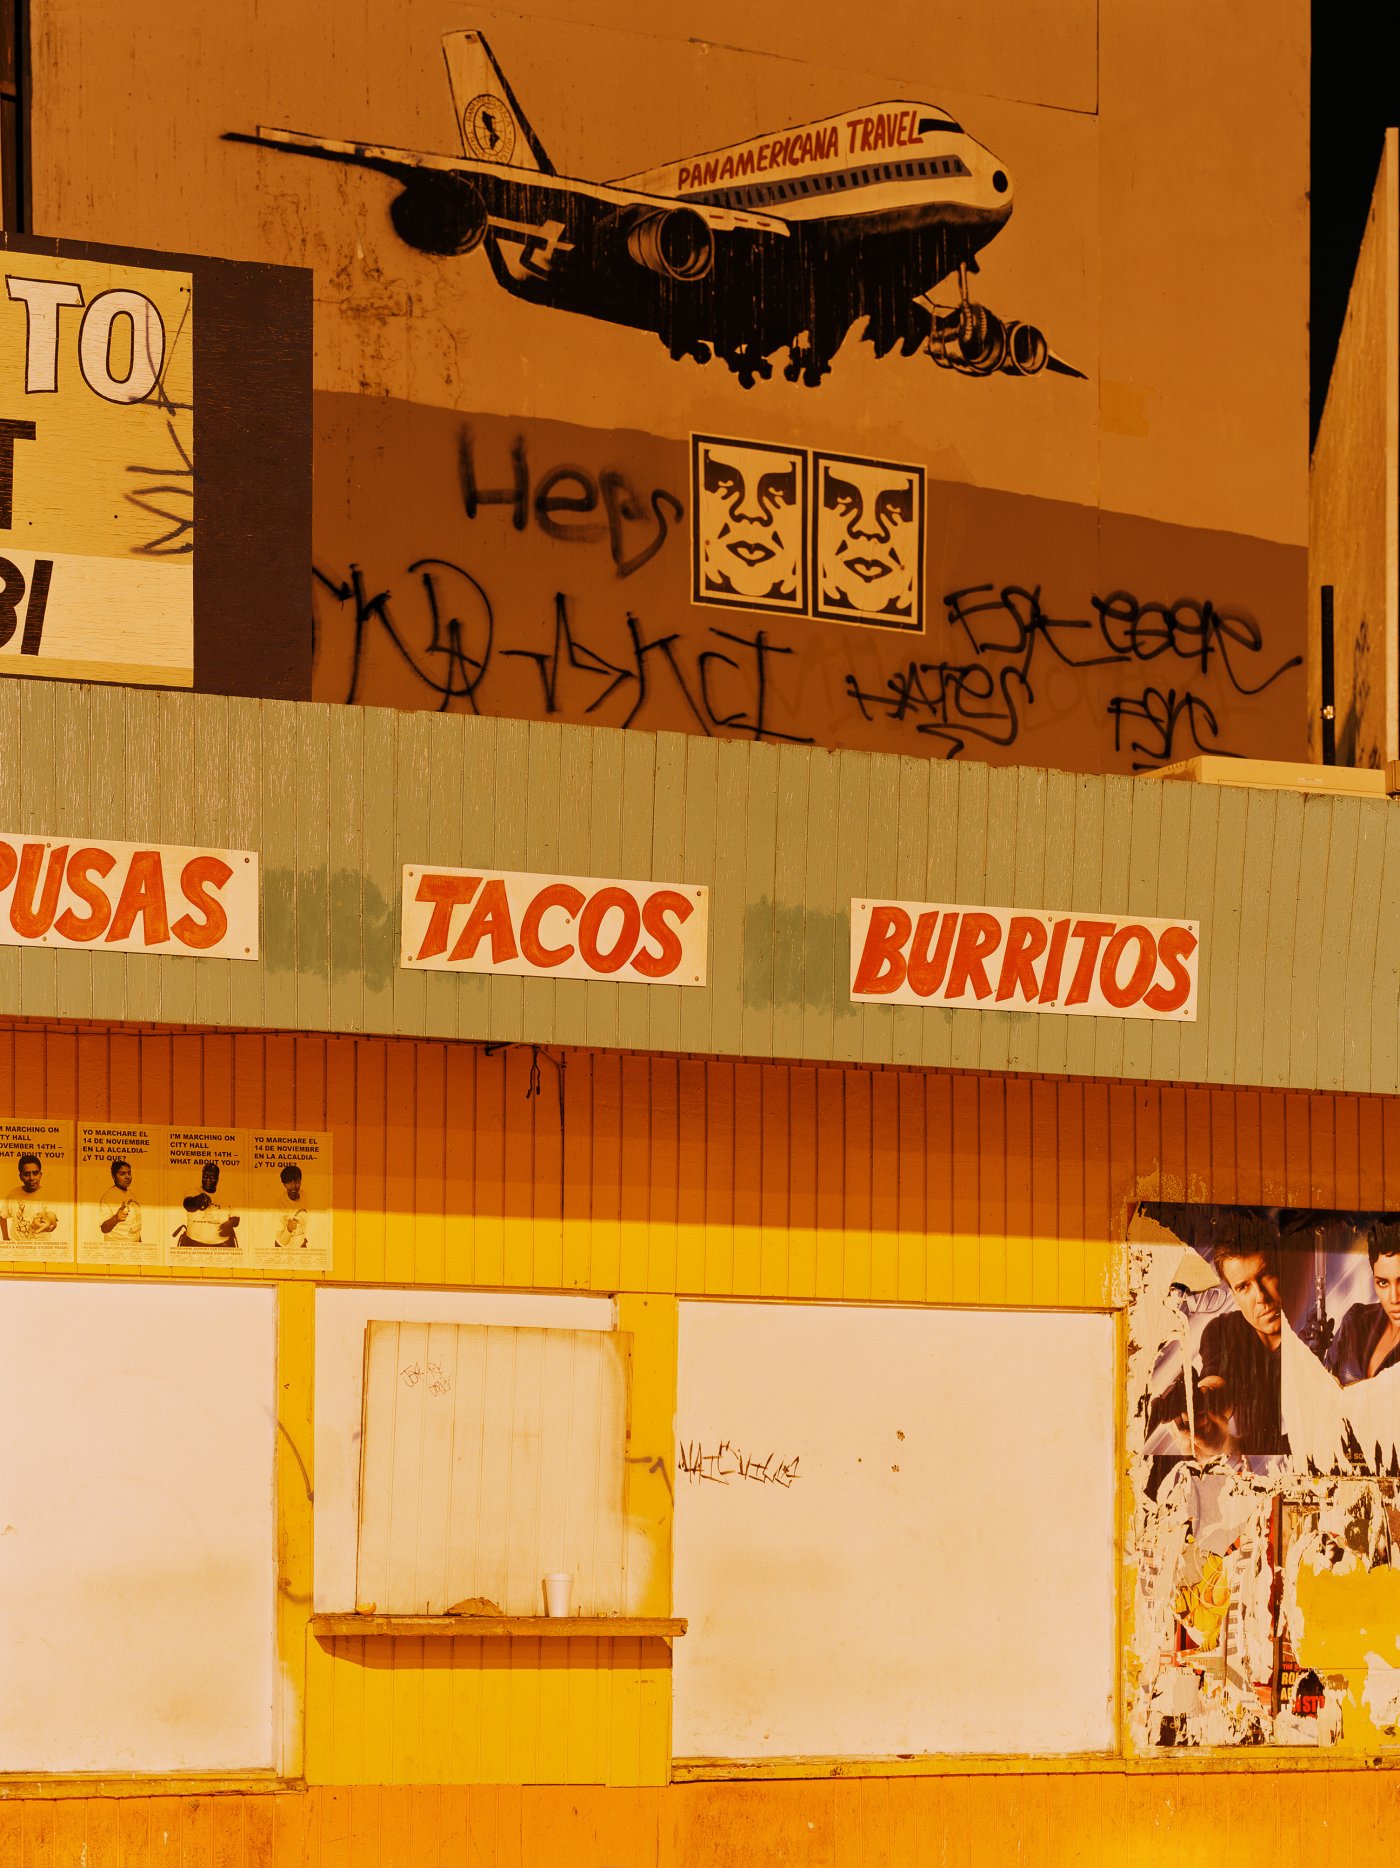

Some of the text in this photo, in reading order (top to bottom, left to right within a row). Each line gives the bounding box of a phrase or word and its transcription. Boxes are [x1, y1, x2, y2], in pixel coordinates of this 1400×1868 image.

[677, 110, 924, 190] PANAMERICANA TRAVEL
[5, 275, 166, 405] TO
[414, 873, 695, 978] TACOS
[852, 905, 1199, 1012] BURRITOS
[106, 1138, 150, 1146] NOVIEMBRE
